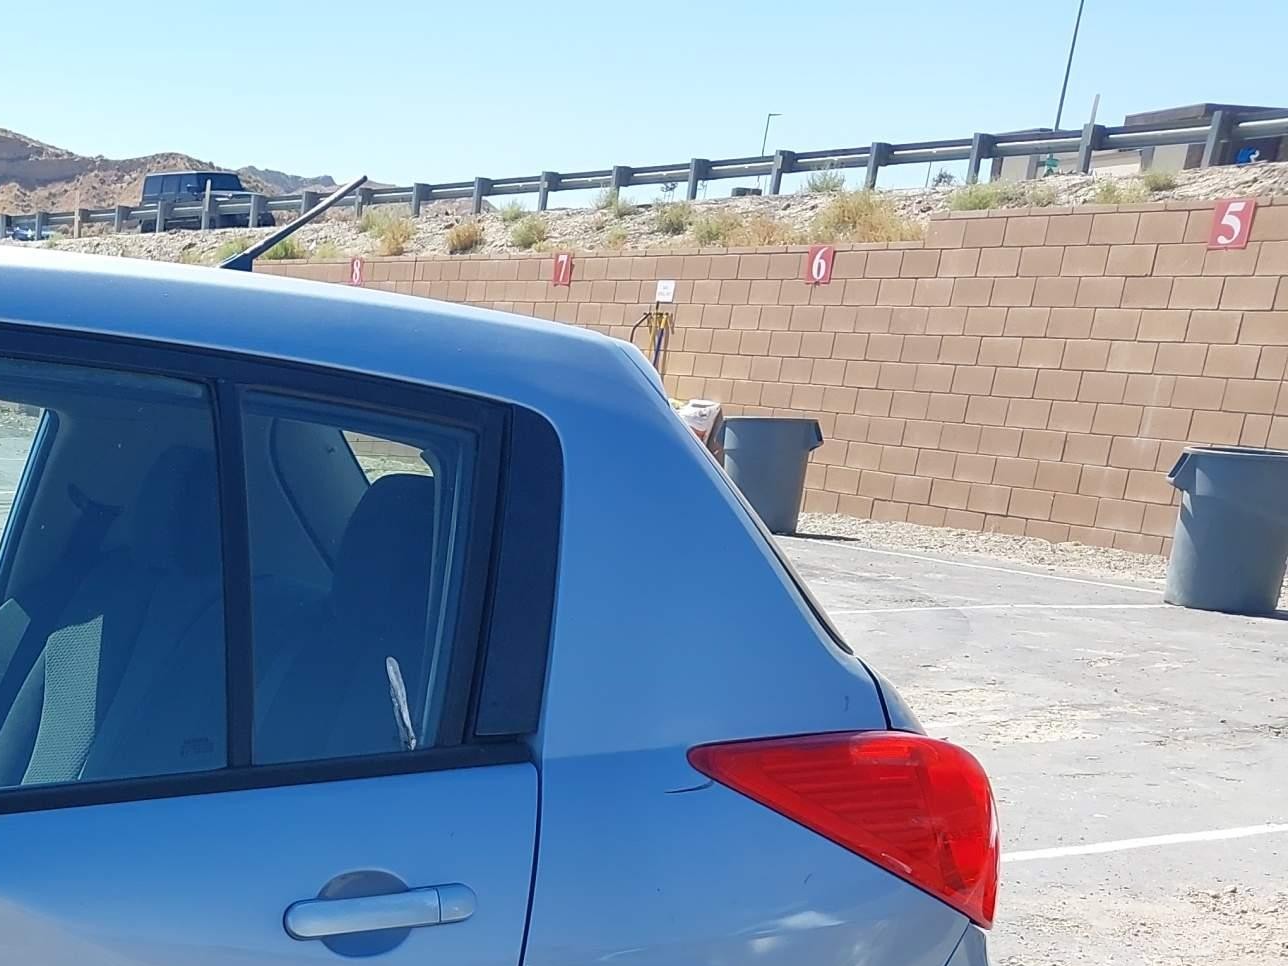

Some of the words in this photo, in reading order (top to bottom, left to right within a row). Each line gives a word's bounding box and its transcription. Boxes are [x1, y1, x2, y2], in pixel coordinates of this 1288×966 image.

[1216, 201, 1246, 244] 5
[352, 259, 361, 284] 8
[558, 254, 568, 282] 7
[812, 247, 828, 280] 6
